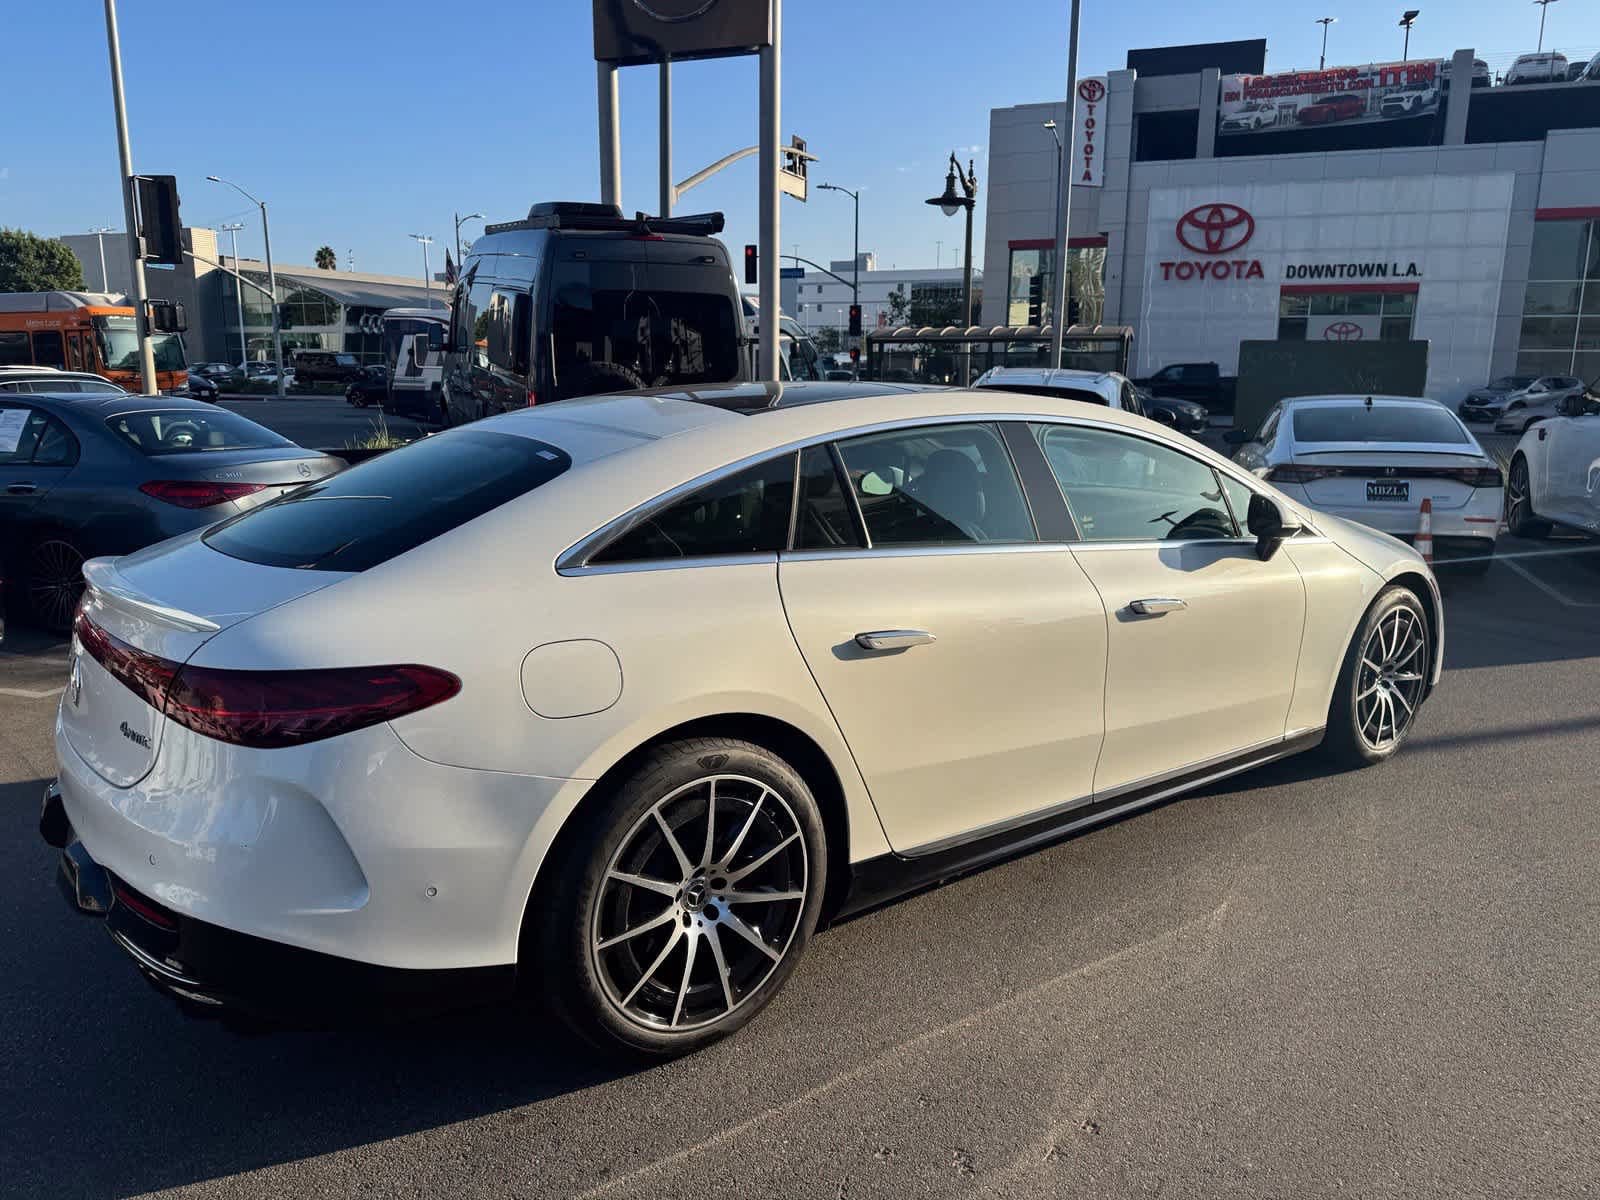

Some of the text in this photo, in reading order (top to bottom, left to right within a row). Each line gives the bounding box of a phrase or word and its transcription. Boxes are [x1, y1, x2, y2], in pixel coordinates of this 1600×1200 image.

[1347, 79, 1374, 90] CON
[1380, 62, 1436, 86] ITIN
[1082, 104, 1096, 181] TOYOTA
[1160, 260, 1264, 281] TOYOTA
[1285, 262, 1423, 279] DOWNTOWN L.A.
[1367, 486, 1408, 496] MBZLA
